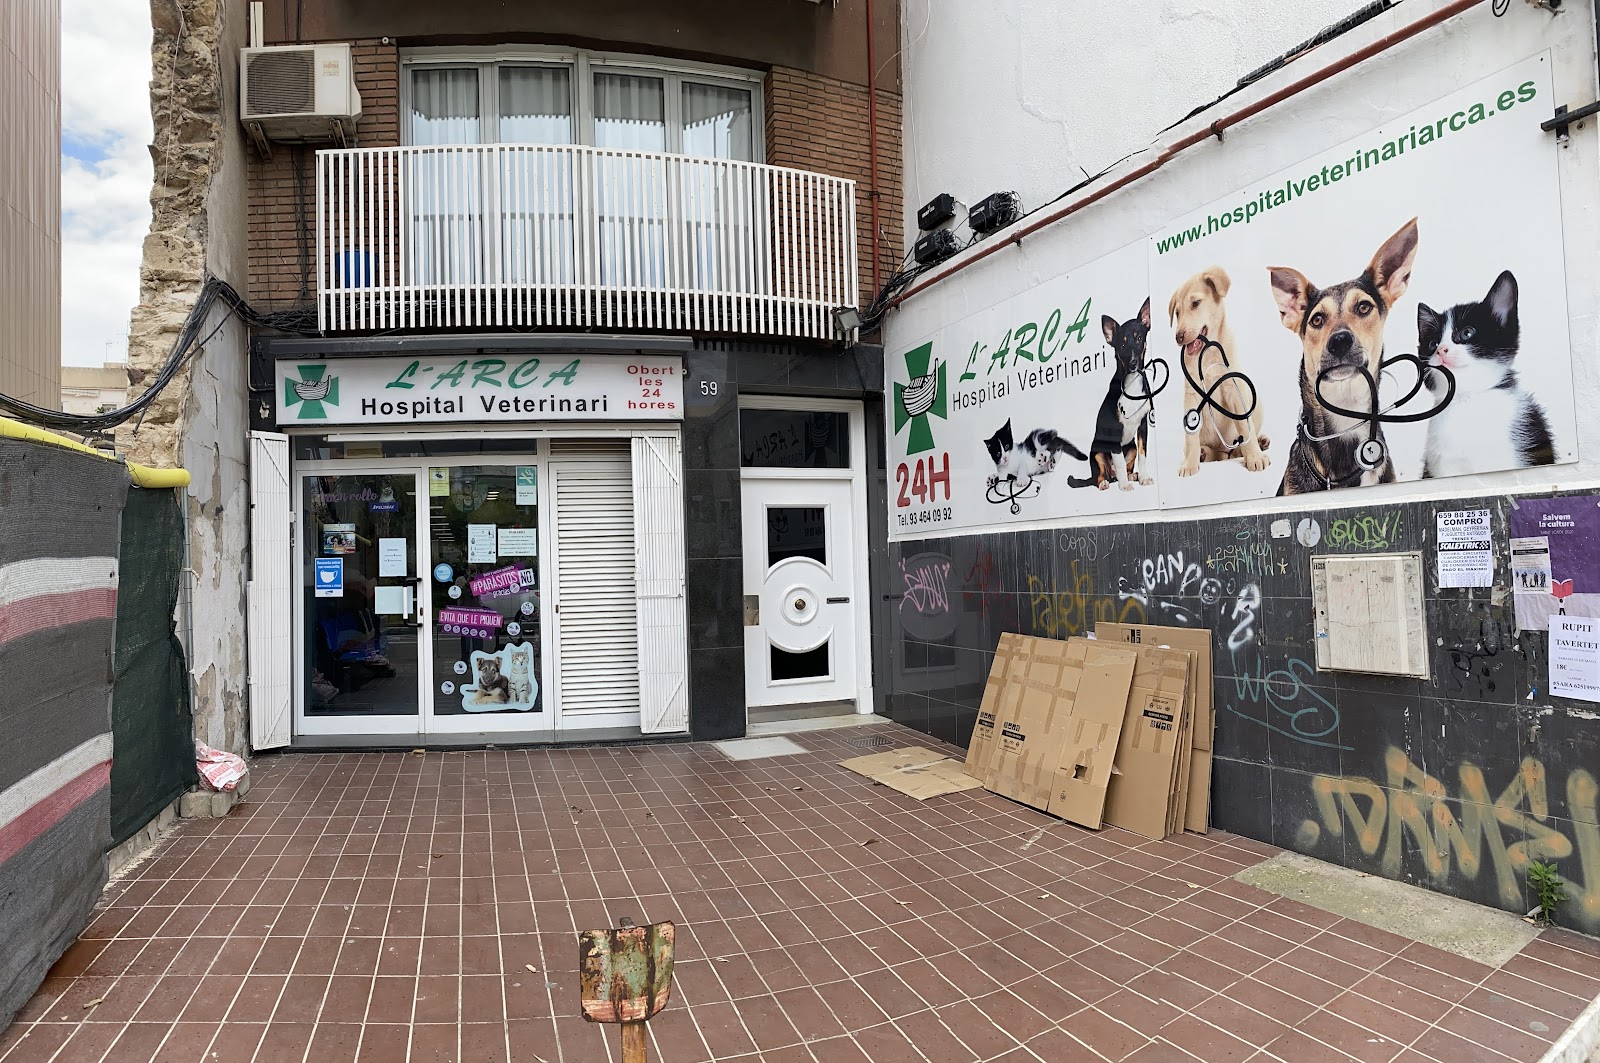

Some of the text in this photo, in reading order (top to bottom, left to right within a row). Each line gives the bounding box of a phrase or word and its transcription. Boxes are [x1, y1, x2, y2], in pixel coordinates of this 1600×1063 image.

[1156, 80, 1537, 255] www.hospitalveterinariarca.es
[959, 297, 1092, 383] L'ARCA
[627, 365, 674, 375] Obert
[639, 376, 663, 386] les
[953, 346, 1107, 411] Hospital Veterinari
[642, 388, 661, 398] 24
[700, 381, 718, 396] 59
[361, 394, 608, 419] Hospital Veterinari
[628, 400, 675, 410] hores
[896, 452, 951, 508] 24H
[897, 507, 952, 526] Tel. 93 464 09 92
[521, 570, 532, 584] NO
[441, 612, 501, 626] EVITA QUE LE PIQUEN
[1562, 623, 1593, 632] RUPIT
[1556, 639, 1600, 649] TAVERTET
